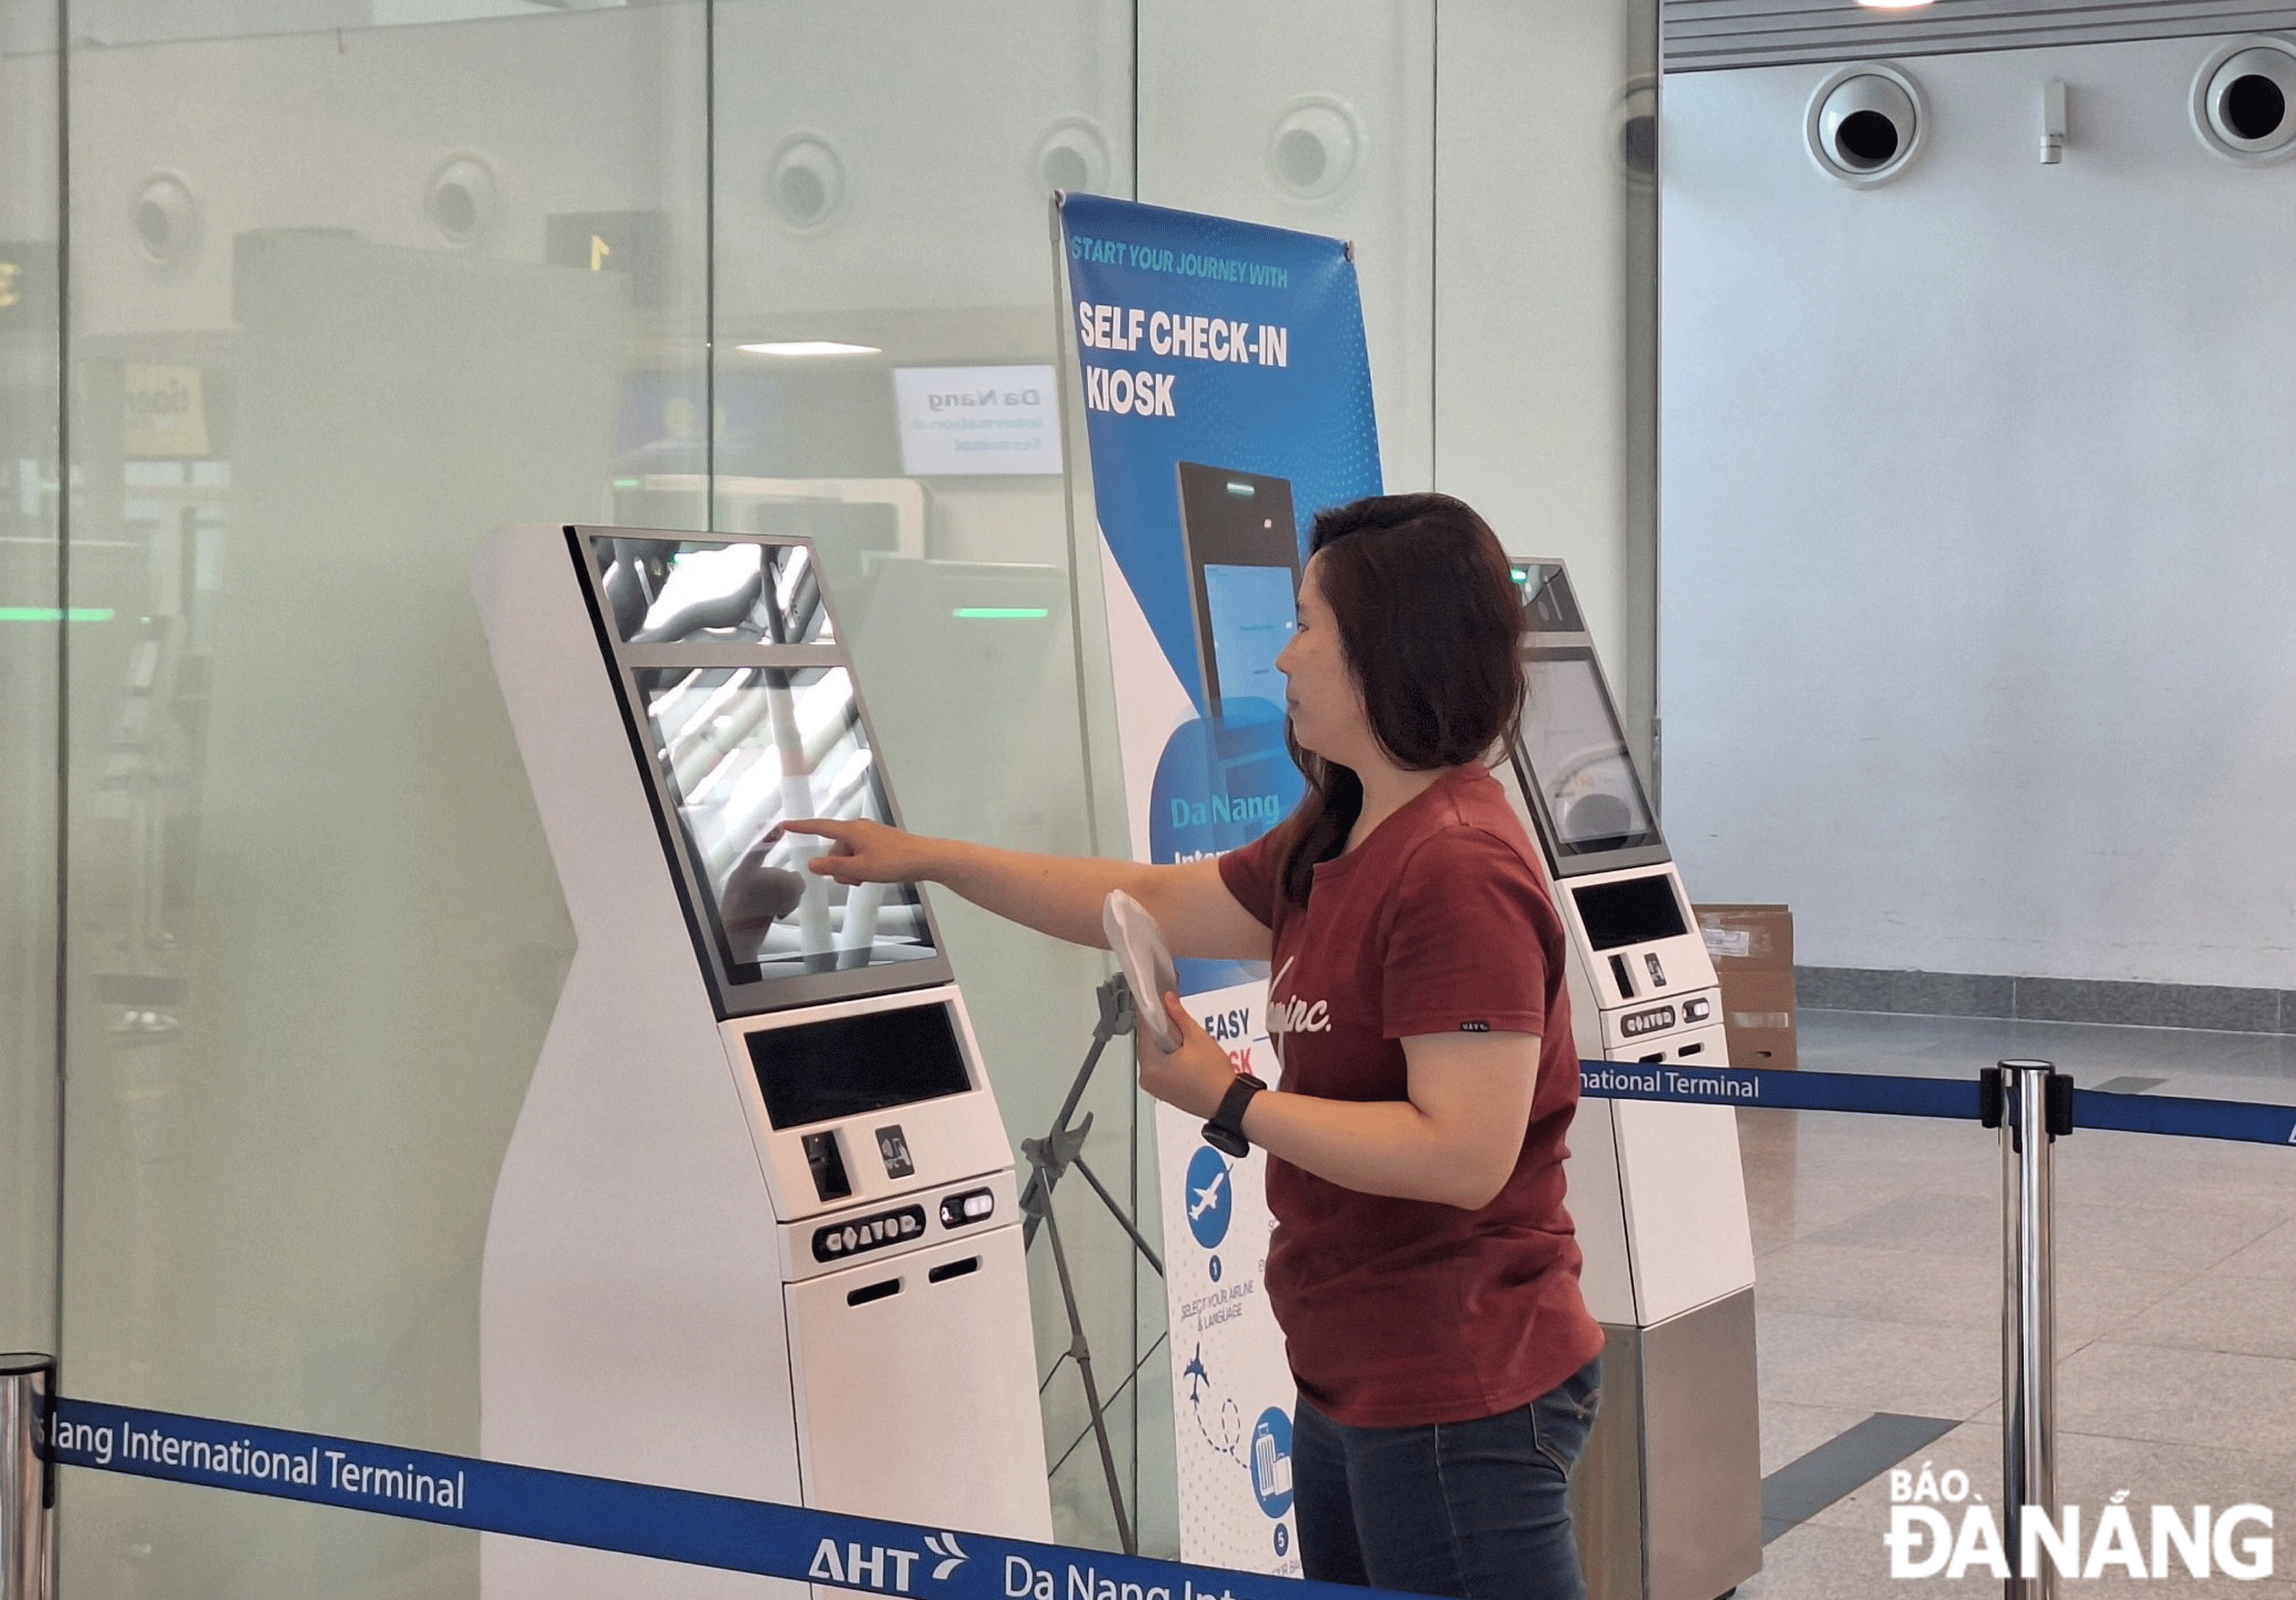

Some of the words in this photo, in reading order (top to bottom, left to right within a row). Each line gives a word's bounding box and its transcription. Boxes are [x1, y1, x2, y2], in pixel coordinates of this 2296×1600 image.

[1072, 235, 1127, 265] START
[1129, 244, 1173, 273] YOUR
[1176, 252, 1249, 283] JOURNEY
[1248, 262, 1288, 289] WITH
[1079, 301, 1145, 351] SELF
[1150, 311, 1287, 367] CHECK-IN
[1086, 365, 1176, 417] KIOSK
[1170, 798, 1207, 829] Da
[1212, 793, 1280, 825] Nang
[1204, 1007, 1249, 1042] EASY
[1664, 1071, 1759, 1098] Terminal
[123, 1421, 318, 1485] International
[325, 1450, 464, 1509] Terminal
[808, 1537, 920, 1592] AHT
[1005, 1555, 1055, 1600] Da
